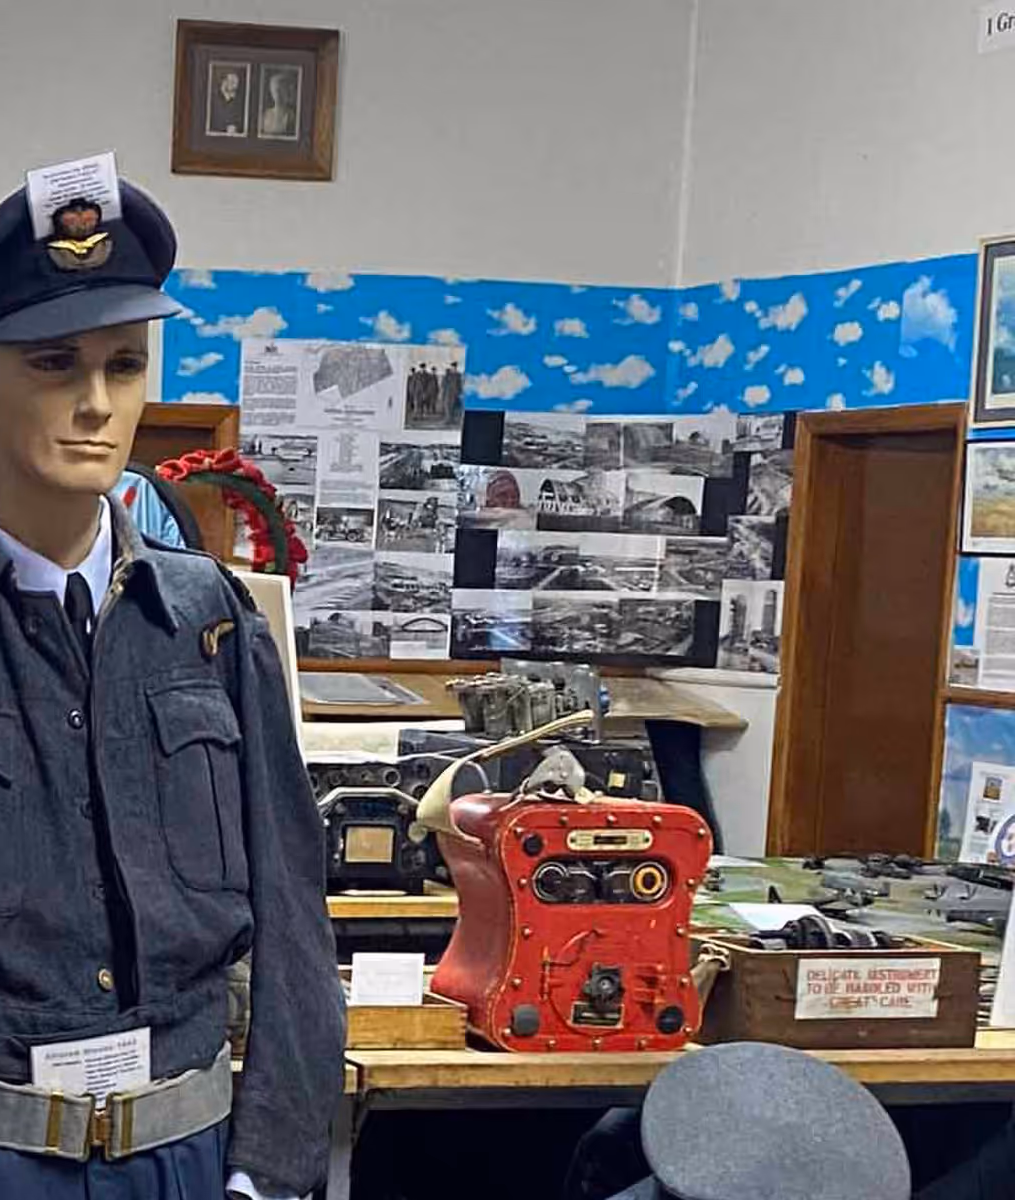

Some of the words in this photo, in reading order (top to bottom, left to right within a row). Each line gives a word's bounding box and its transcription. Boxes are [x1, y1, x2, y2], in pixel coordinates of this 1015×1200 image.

[807, 968, 862, 981] DELICATE
[867, 967, 939, 981] INSTRUMENT
[808, 981, 823, 995] TO
[824, 981, 843, 995] BE
[845, 981, 901, 995] HANDLED
[878, 995, 913, 1009] CARE
